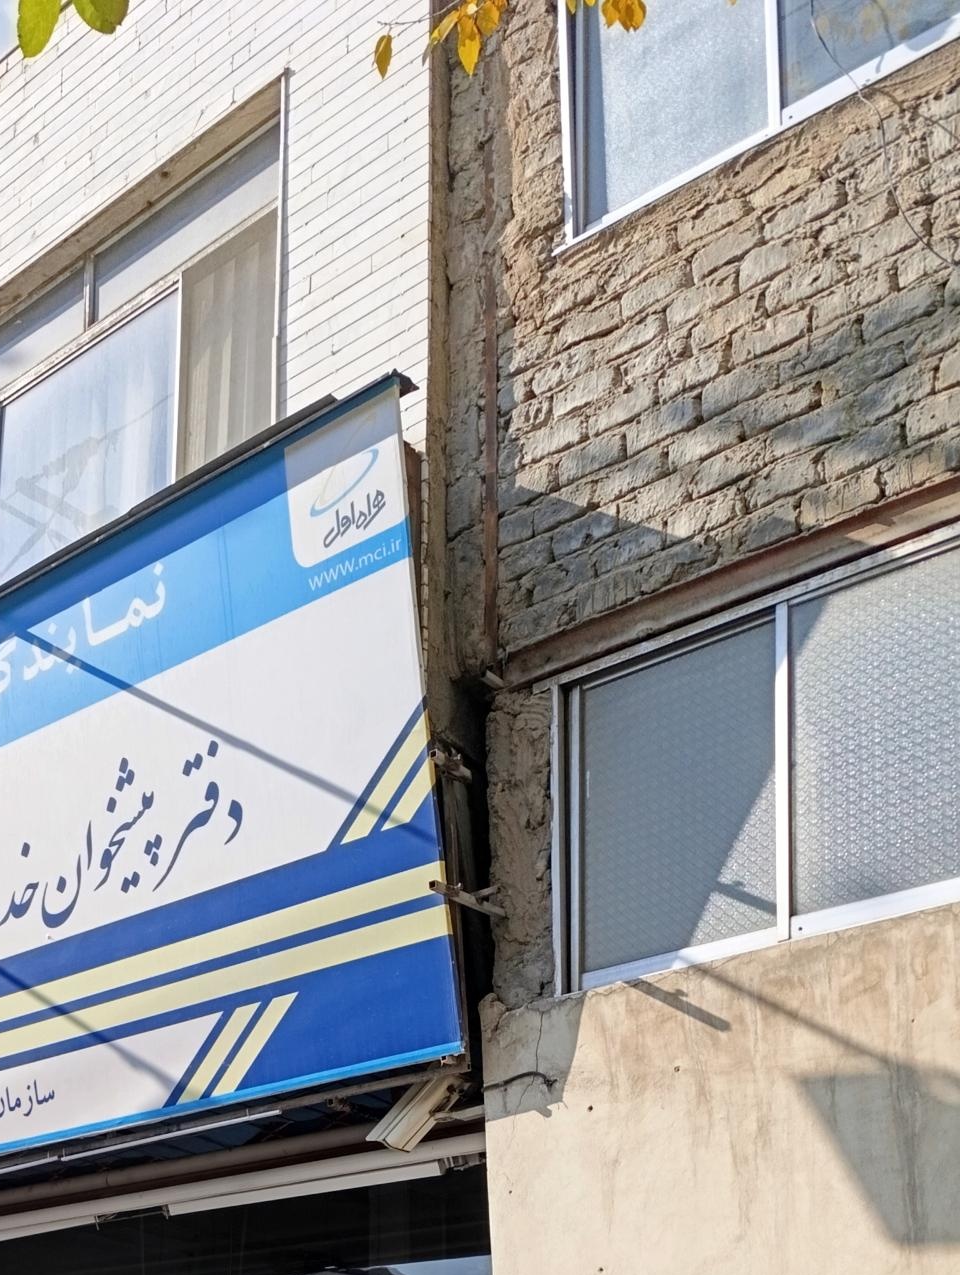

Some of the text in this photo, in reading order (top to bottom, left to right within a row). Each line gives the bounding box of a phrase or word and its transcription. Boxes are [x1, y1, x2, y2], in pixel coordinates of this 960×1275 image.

[308, 539, 402, 591] www.mci.ir
[41, 757, 164, 929] پیشخوان
[153, 740, 243, 892] دفتر
